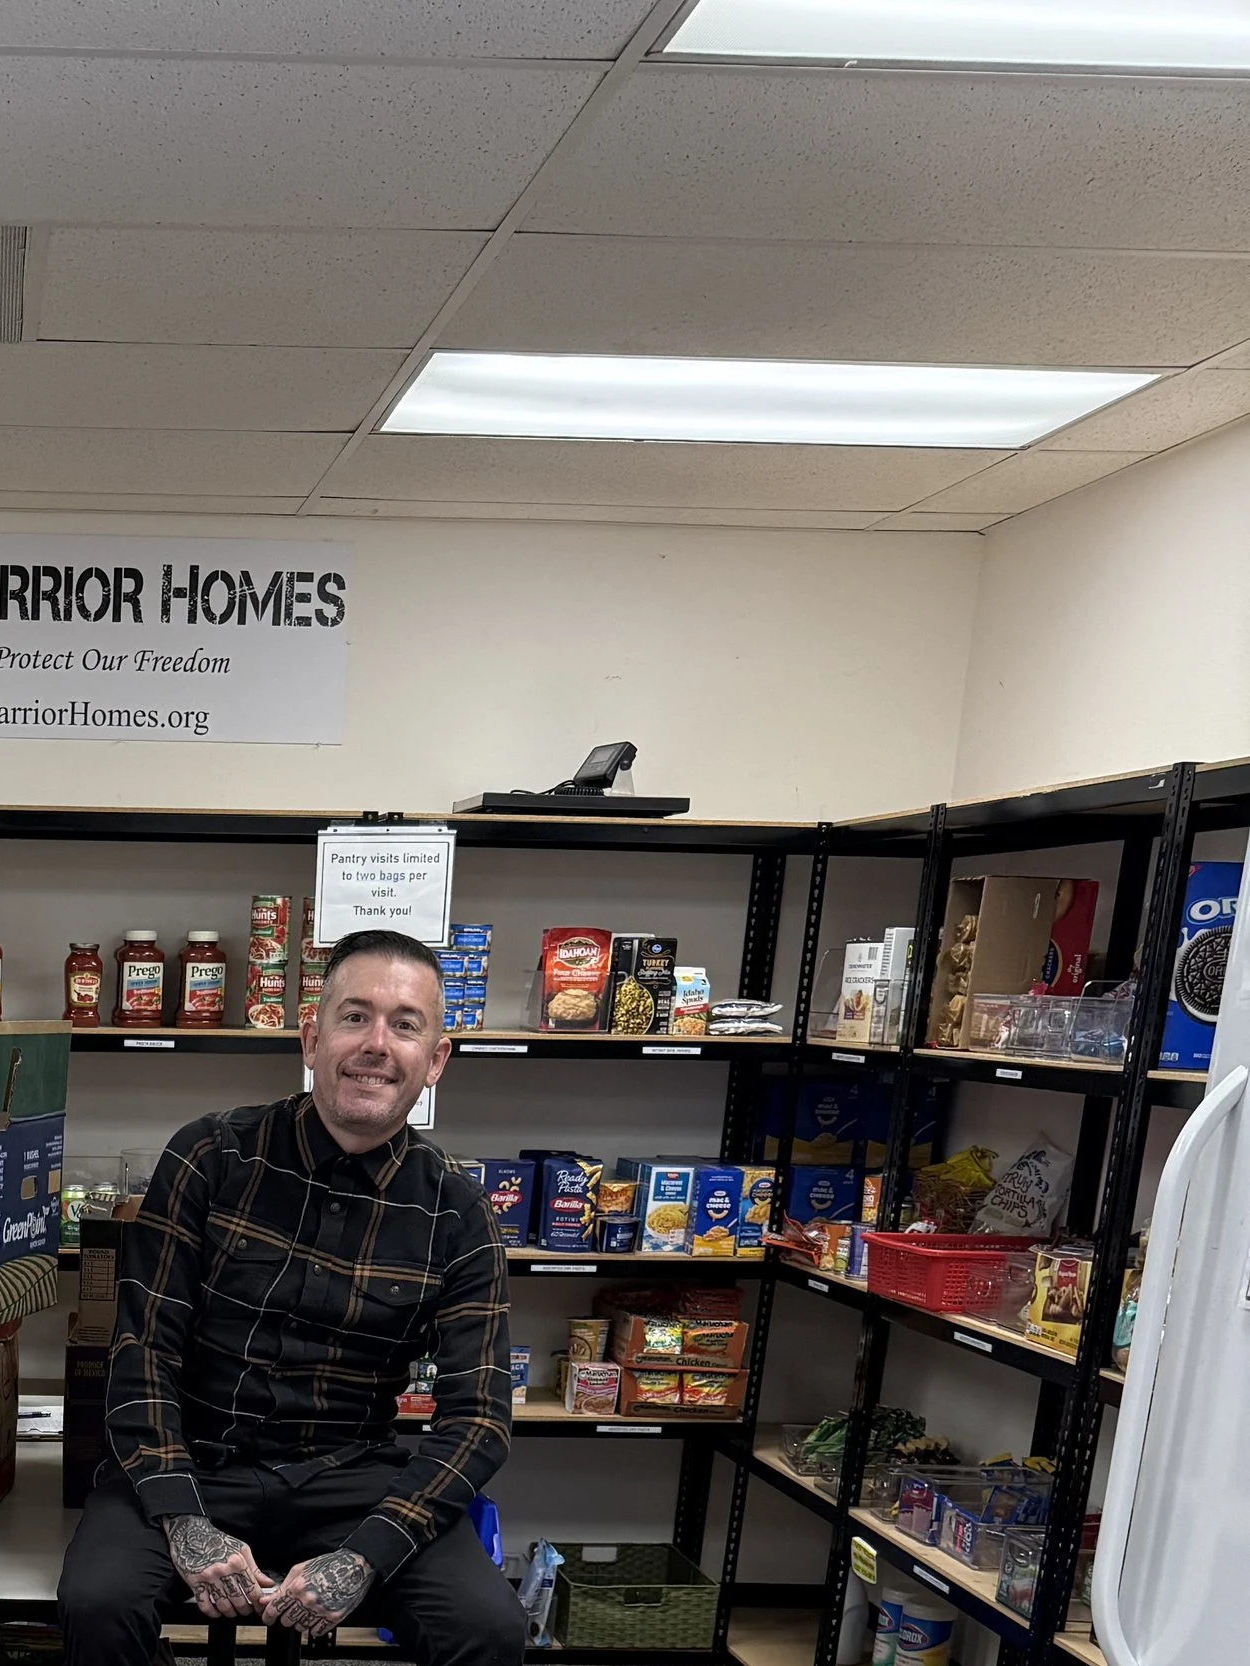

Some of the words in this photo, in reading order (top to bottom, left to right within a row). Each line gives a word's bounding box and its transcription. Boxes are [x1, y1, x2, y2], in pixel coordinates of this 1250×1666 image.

[160, 564, 347, 628] HOMES
[82, 649, 128, 672] Our
[133, 649, 231, 675] Freedom
[331, 853, 367, 866] Pantry
[370, 853, 399, 863] visits
[403, 853, 440, 863] limited
[342, 871, 352, 880] to
[356, 871, 376, 880] two
[380, 870, 405, 883] bags
[409, 872, 427, 883] per
[371, 887, 397, 897] visit.
[353, 905, 386, 916] Thank
[389, 905, 412, 918] you!
[559, 946, 597, 958] IDAHOAN
[642, 959, 669, 967] TURKEY
[128, 964, 160, 979] Prego
[191, 964, 223, 979] Prego
[557, 1170, 588, 1184] Ready
[558, 1182, 583, 1194] Pasta
[491, 1193, 519, 1202] Barilla
[554, 1200, 583, 1210] Barilla
[991, 1195, 1027, 1218] CHIPS
[676, 1357, 711, 1367] Chicken
